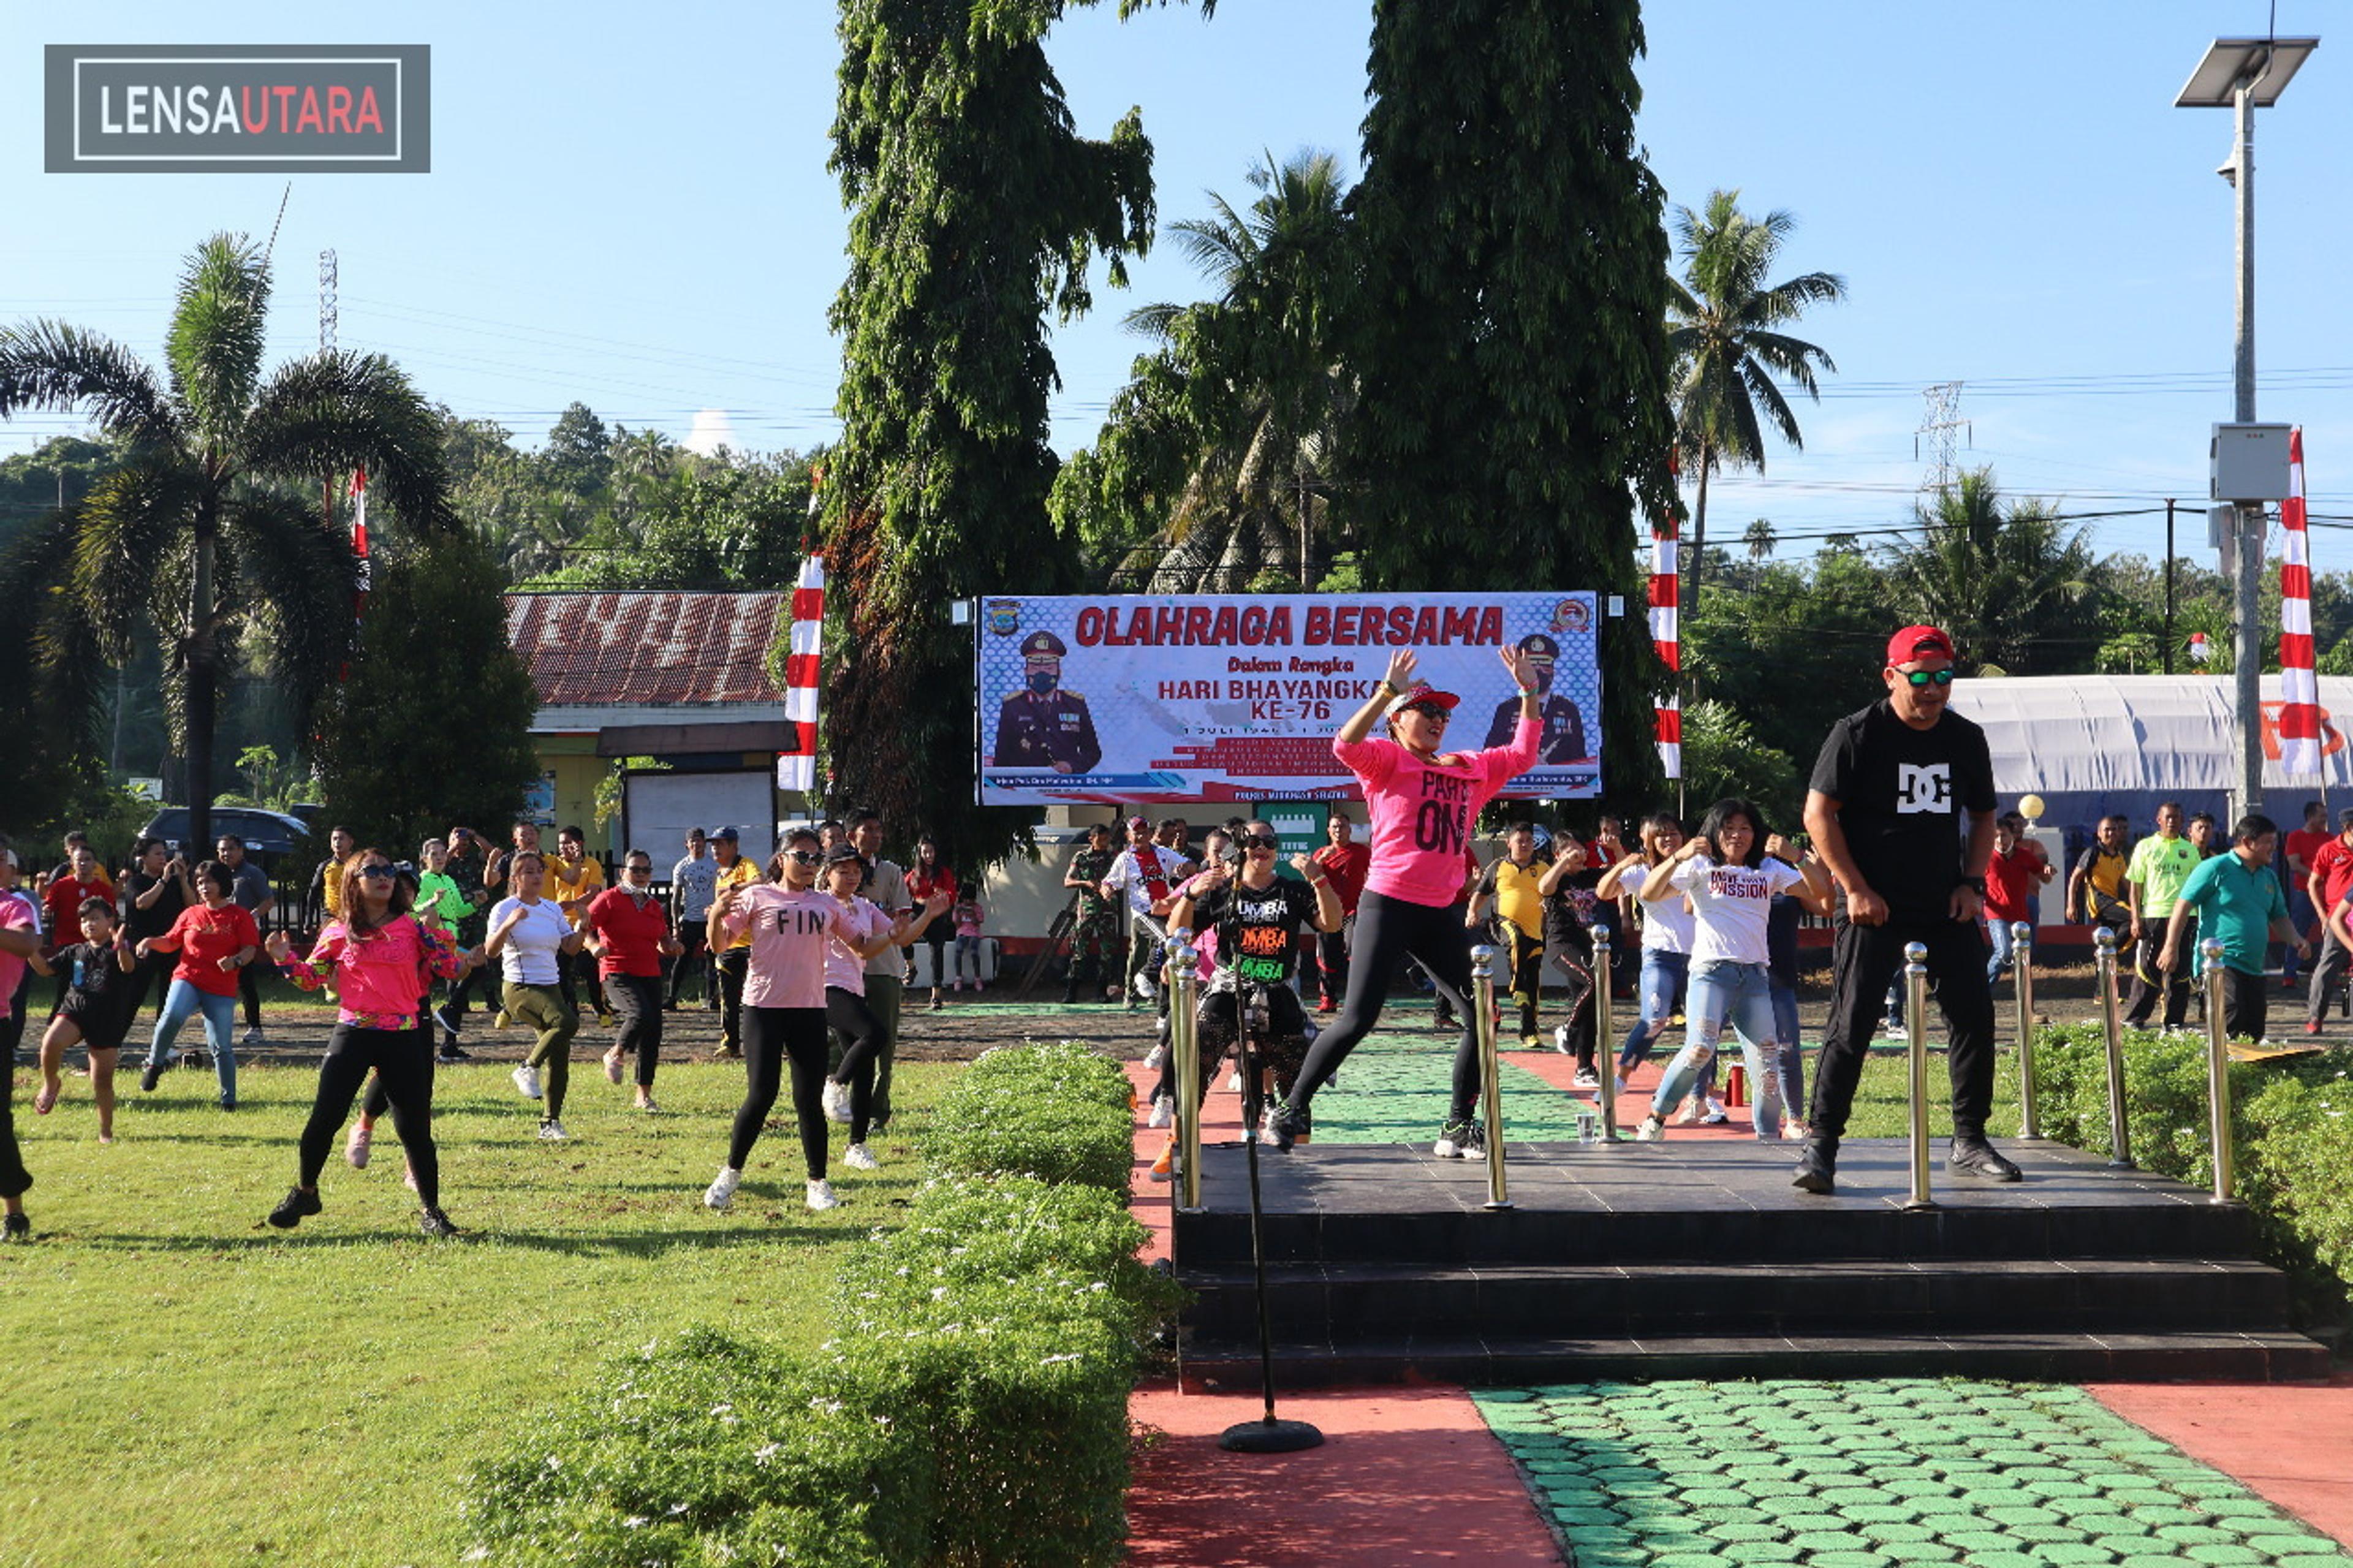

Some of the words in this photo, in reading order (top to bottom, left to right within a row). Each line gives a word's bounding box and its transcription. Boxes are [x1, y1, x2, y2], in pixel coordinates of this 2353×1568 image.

[1075, 605, 1293, 646] OLAHRAGA
[1303, 605, 1504, 646] BERSAMA
[1228, 656, 1282, 672] Dalam
[1289, 656, 1354, 676] Rangka
[1158, 681, 1219, 699] HARI
[1228, 680, 1385, 700] BHAYANGKA
[1251, 701, 1330, 720] KE-76
[1415, 799, 1468, 855] ON
